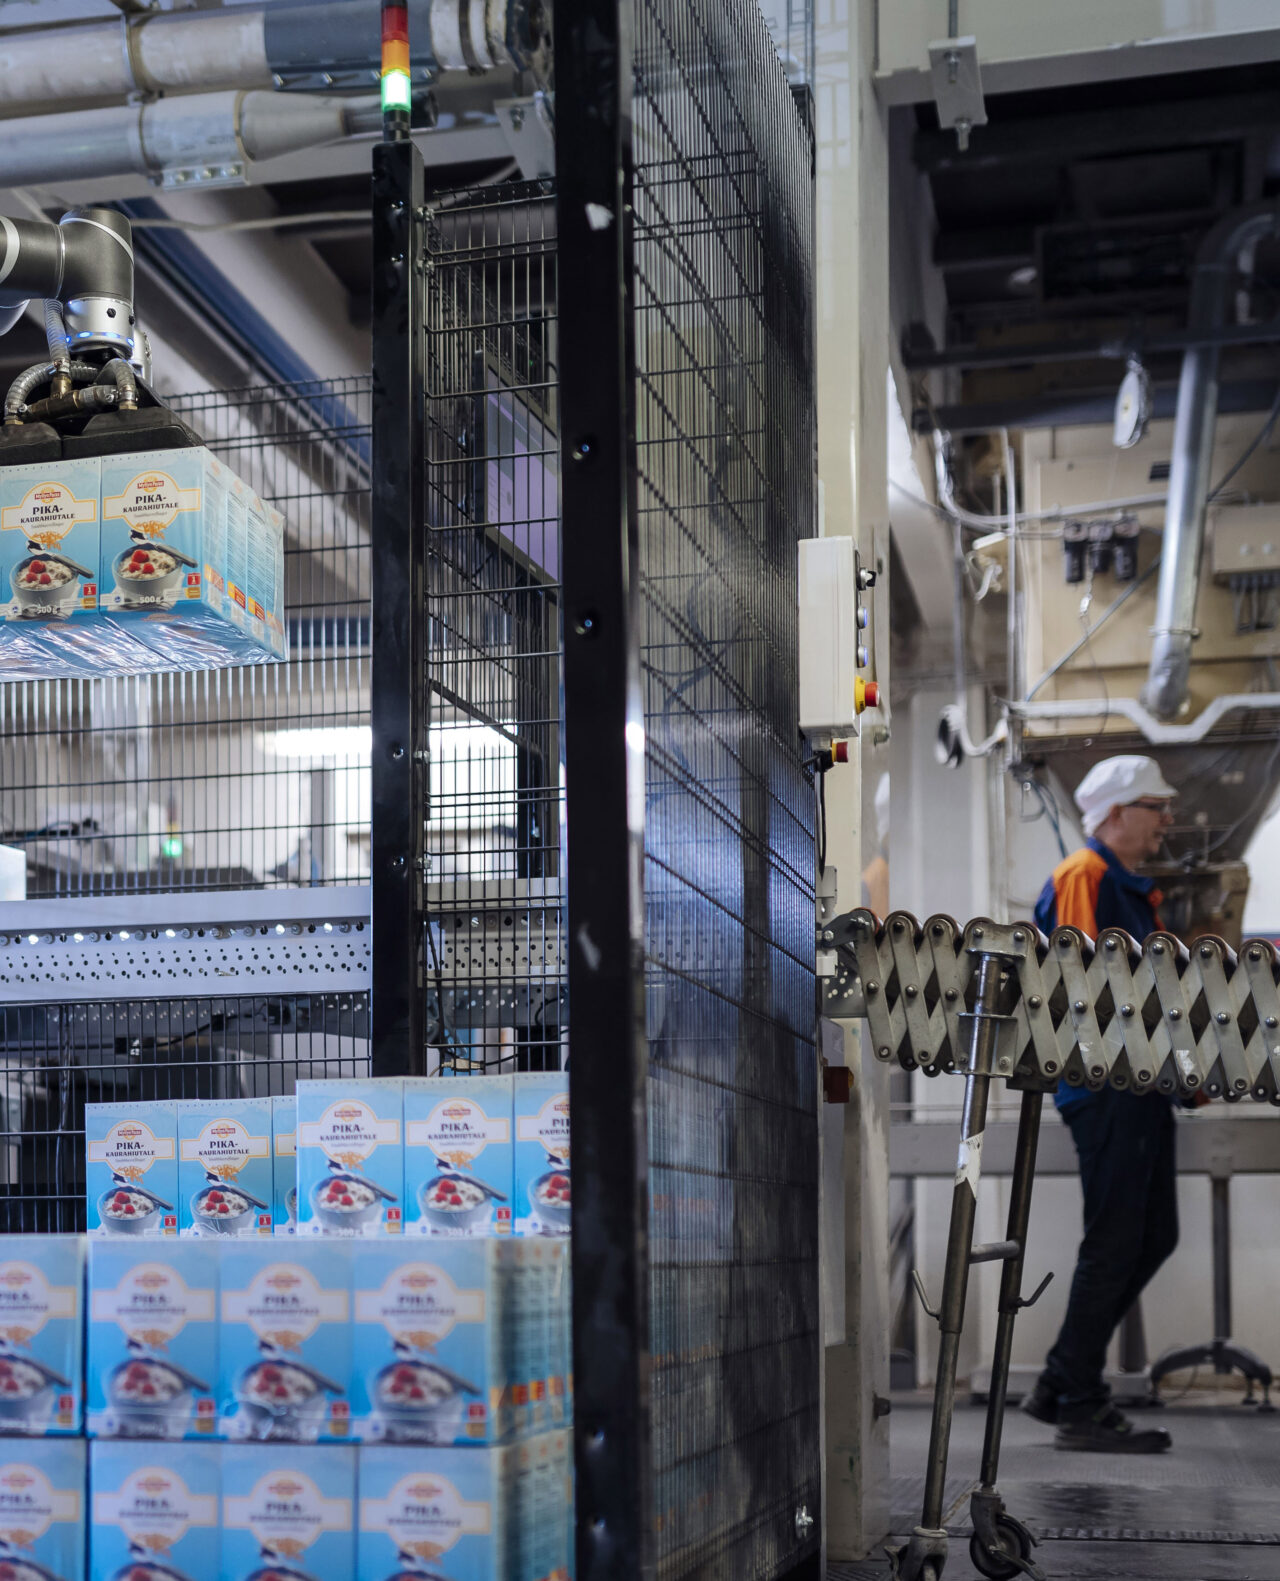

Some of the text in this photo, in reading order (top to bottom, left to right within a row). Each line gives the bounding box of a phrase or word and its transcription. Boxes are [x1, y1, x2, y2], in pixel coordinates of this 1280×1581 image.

[135, 493, 166, 504] PIKA-
[32, 504, 63, 515] PIKA-
[123, 502, 178, 513] KAURAHIUTALE
[20, 513, 75, 524] KAURAHIUTALE
[140, 595, 155, 604] 500
[116, 1141, 144, 1150] PIKA-
[210, 1140, 238, 1149] PIKA-
